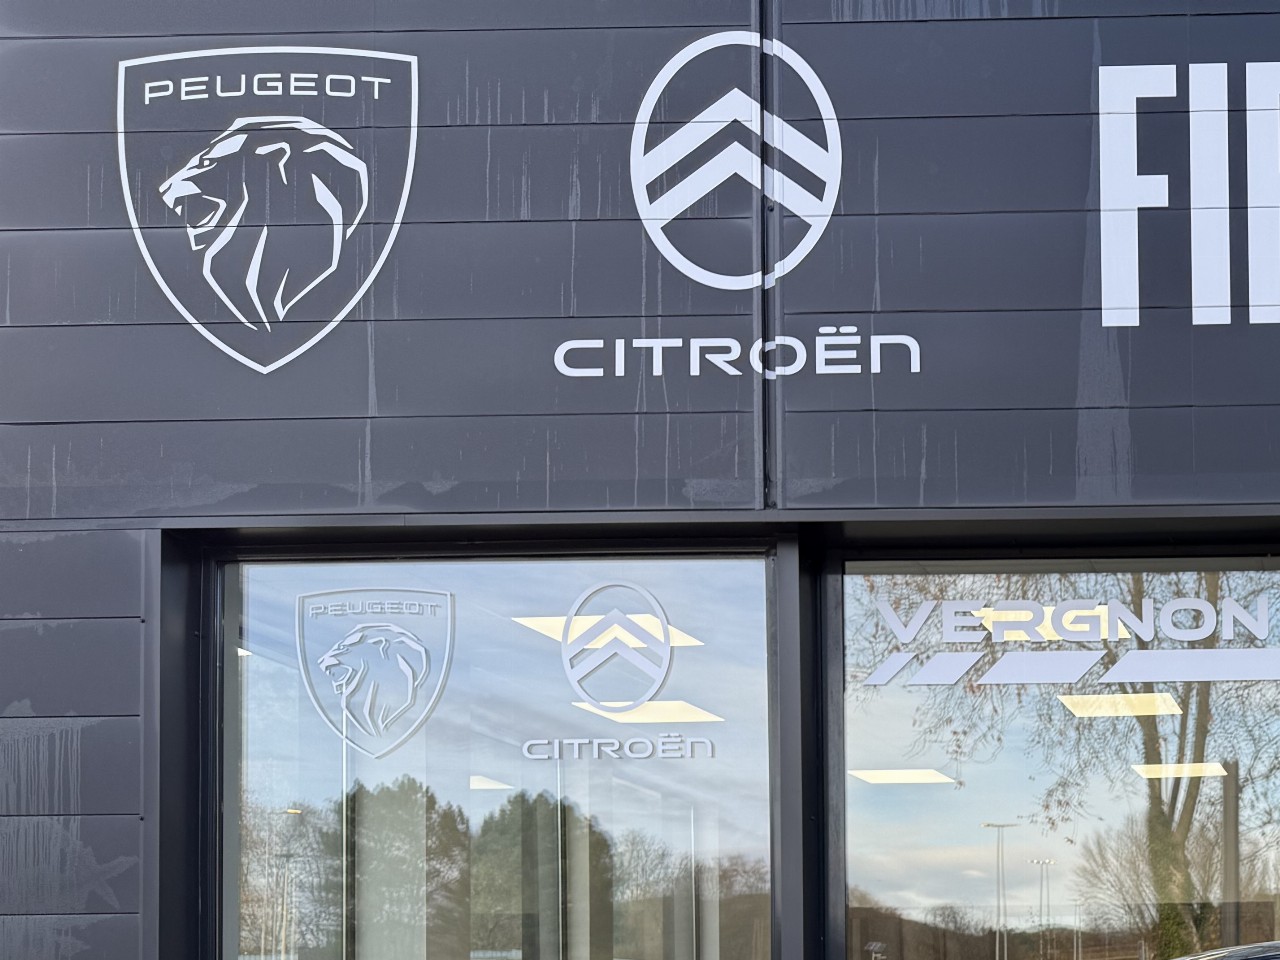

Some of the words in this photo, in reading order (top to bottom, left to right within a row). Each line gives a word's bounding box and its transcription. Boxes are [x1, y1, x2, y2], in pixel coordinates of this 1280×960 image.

[143, 73, 392, 105] PEUGEOT
[553, 325, 921, 380] CITROËN
[309, 600, 441, 618] PEUGEOT
[876, 597, 1270, 643] VERGNON
[521, 733, 716, 761] CITROËN
